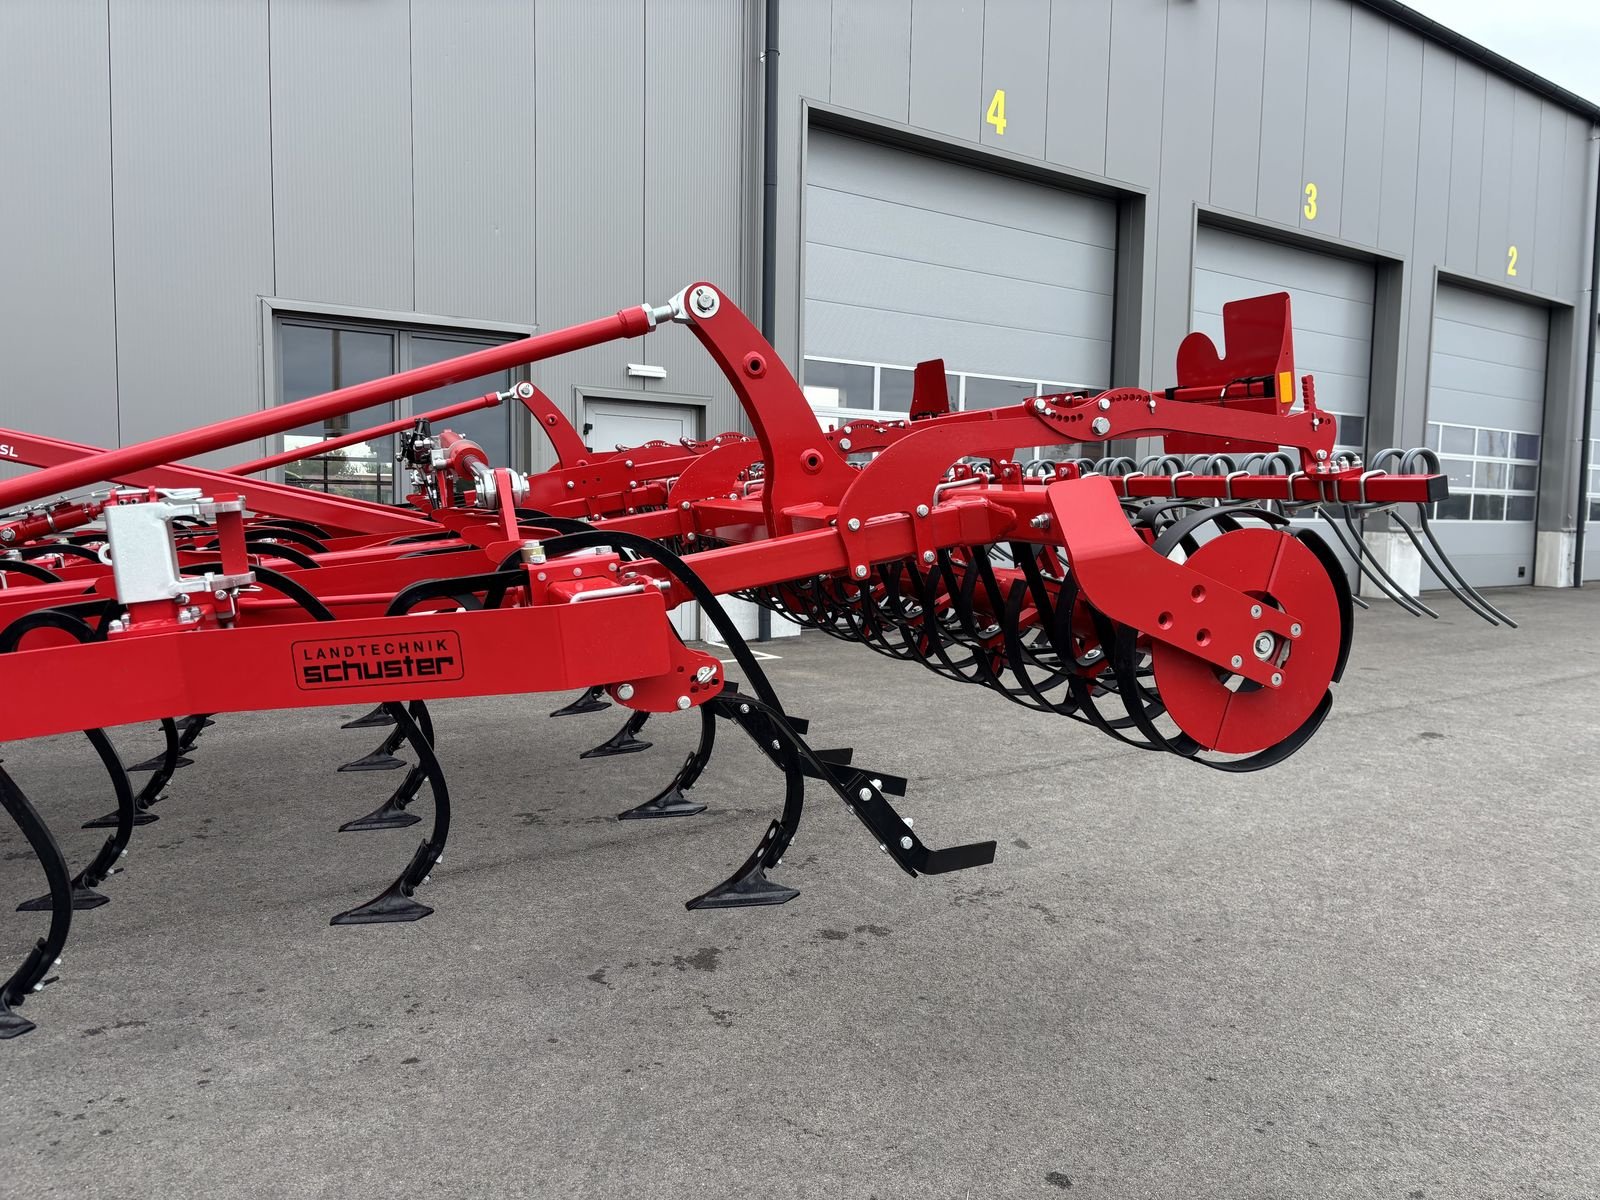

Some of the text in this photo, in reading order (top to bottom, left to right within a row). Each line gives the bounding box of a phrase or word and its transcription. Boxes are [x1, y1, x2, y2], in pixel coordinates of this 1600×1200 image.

[986, 89, 1007, 135] 4
[1304, 183, 1318, 220] 3
[1507, 246, 1518, 276] 2
[303, 639, 448, 660] LANDTECHNIK
[303, 656, 454, 683] schuster
